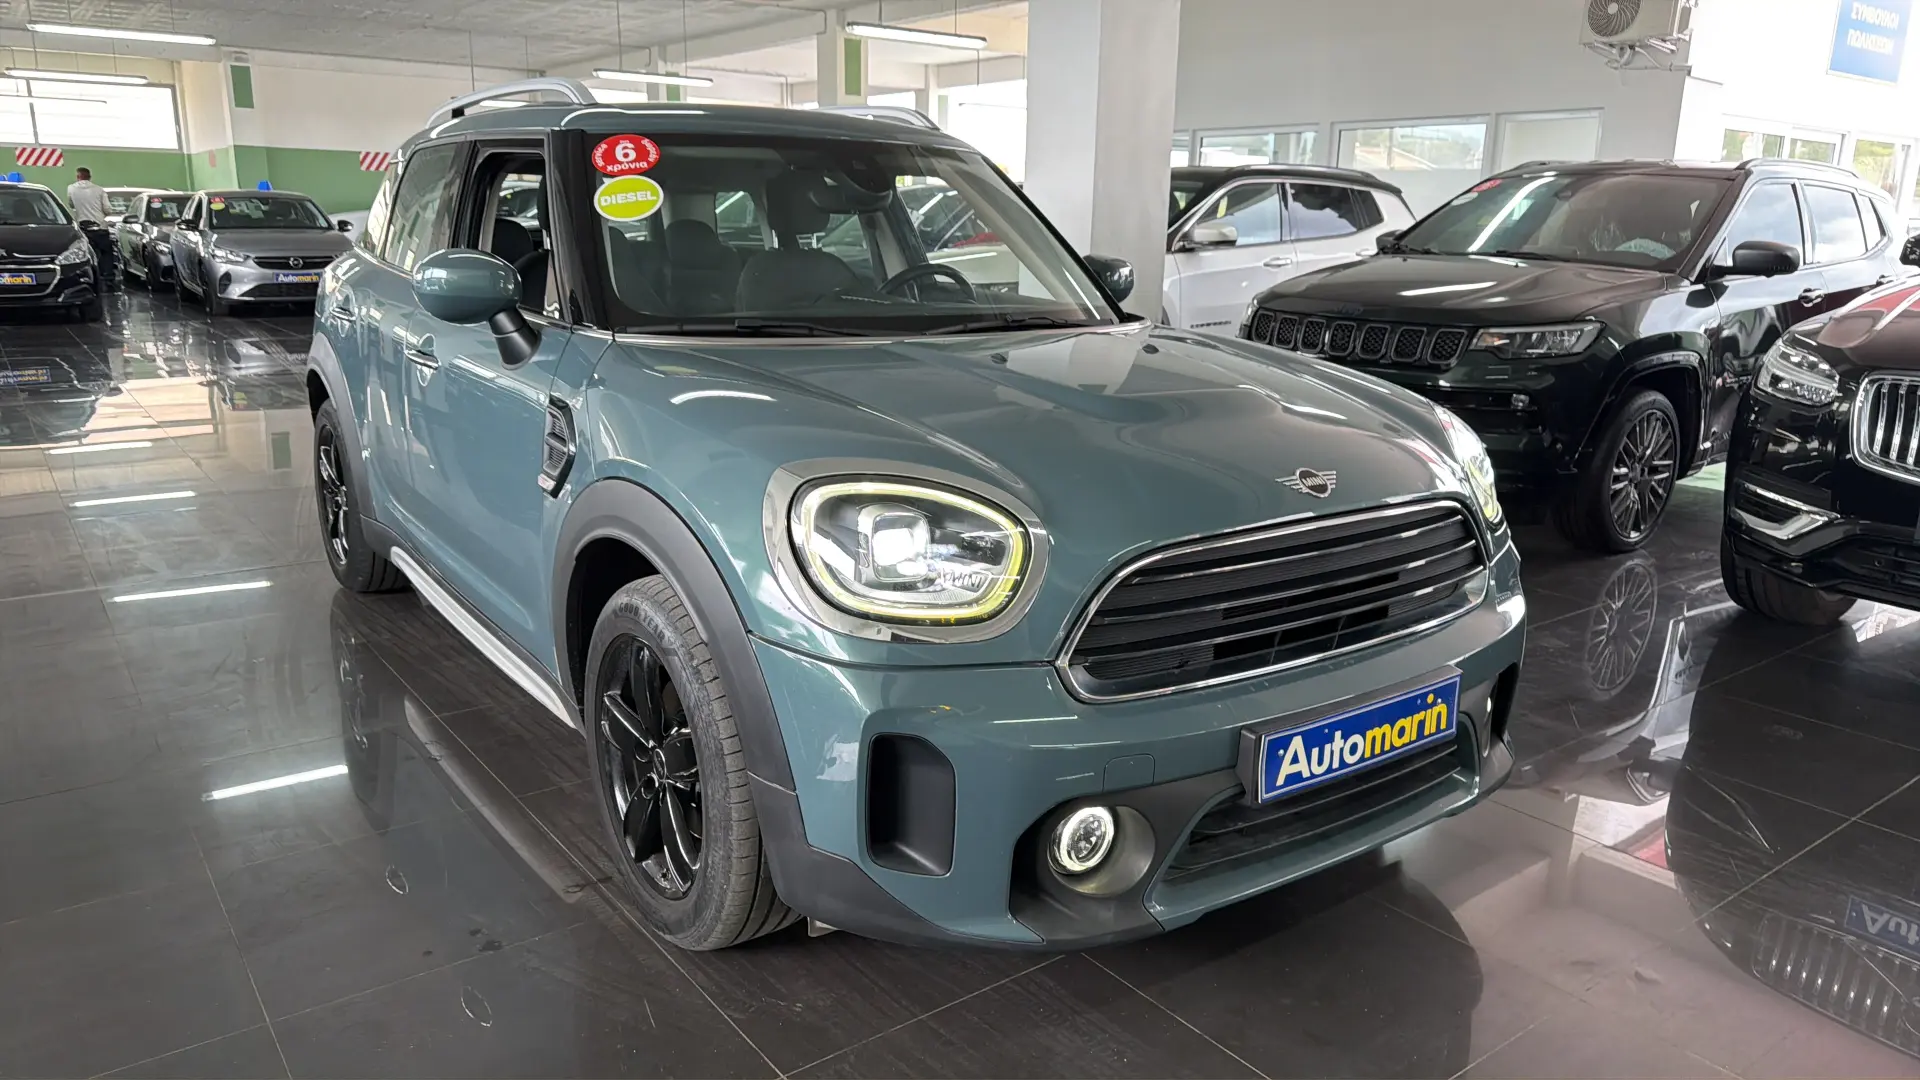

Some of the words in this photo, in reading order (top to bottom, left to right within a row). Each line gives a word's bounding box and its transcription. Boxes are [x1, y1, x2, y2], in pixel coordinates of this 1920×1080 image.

[615, 142, 637, 162] 6
[606, 161, 648, 172] χρόνια
[600, 190, 657, 207] DIESEL
[278, 273, 319, 283] Automarin
[1301, 475, 1326, 487] MINI
[1275, 693, 1448, 787] Automarin
